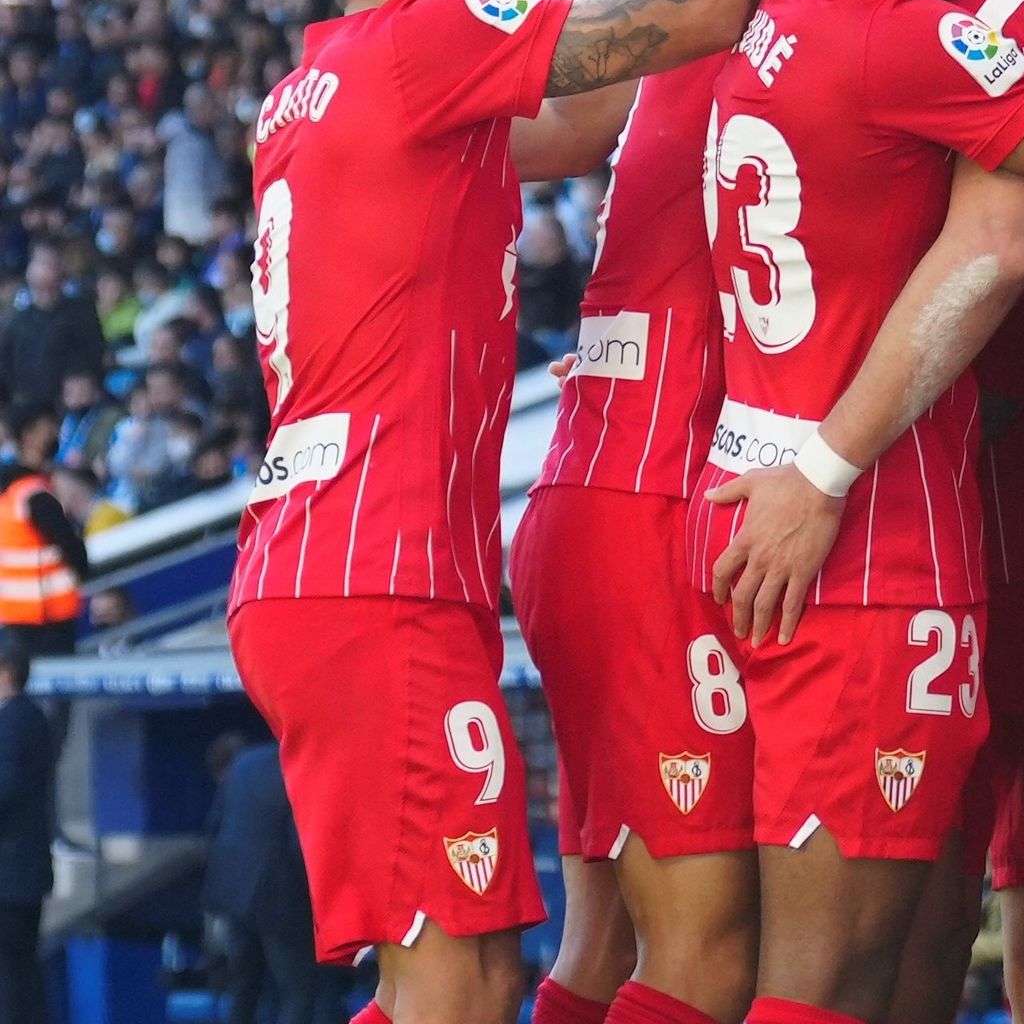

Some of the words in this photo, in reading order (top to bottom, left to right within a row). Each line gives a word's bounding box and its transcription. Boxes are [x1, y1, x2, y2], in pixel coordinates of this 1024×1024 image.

[984, 47, 1019, 85] LaLiga
[686, 634, 748, 734] 8
[905, 609, 980, 718] 23
[444, 701, 505, 806] 9
